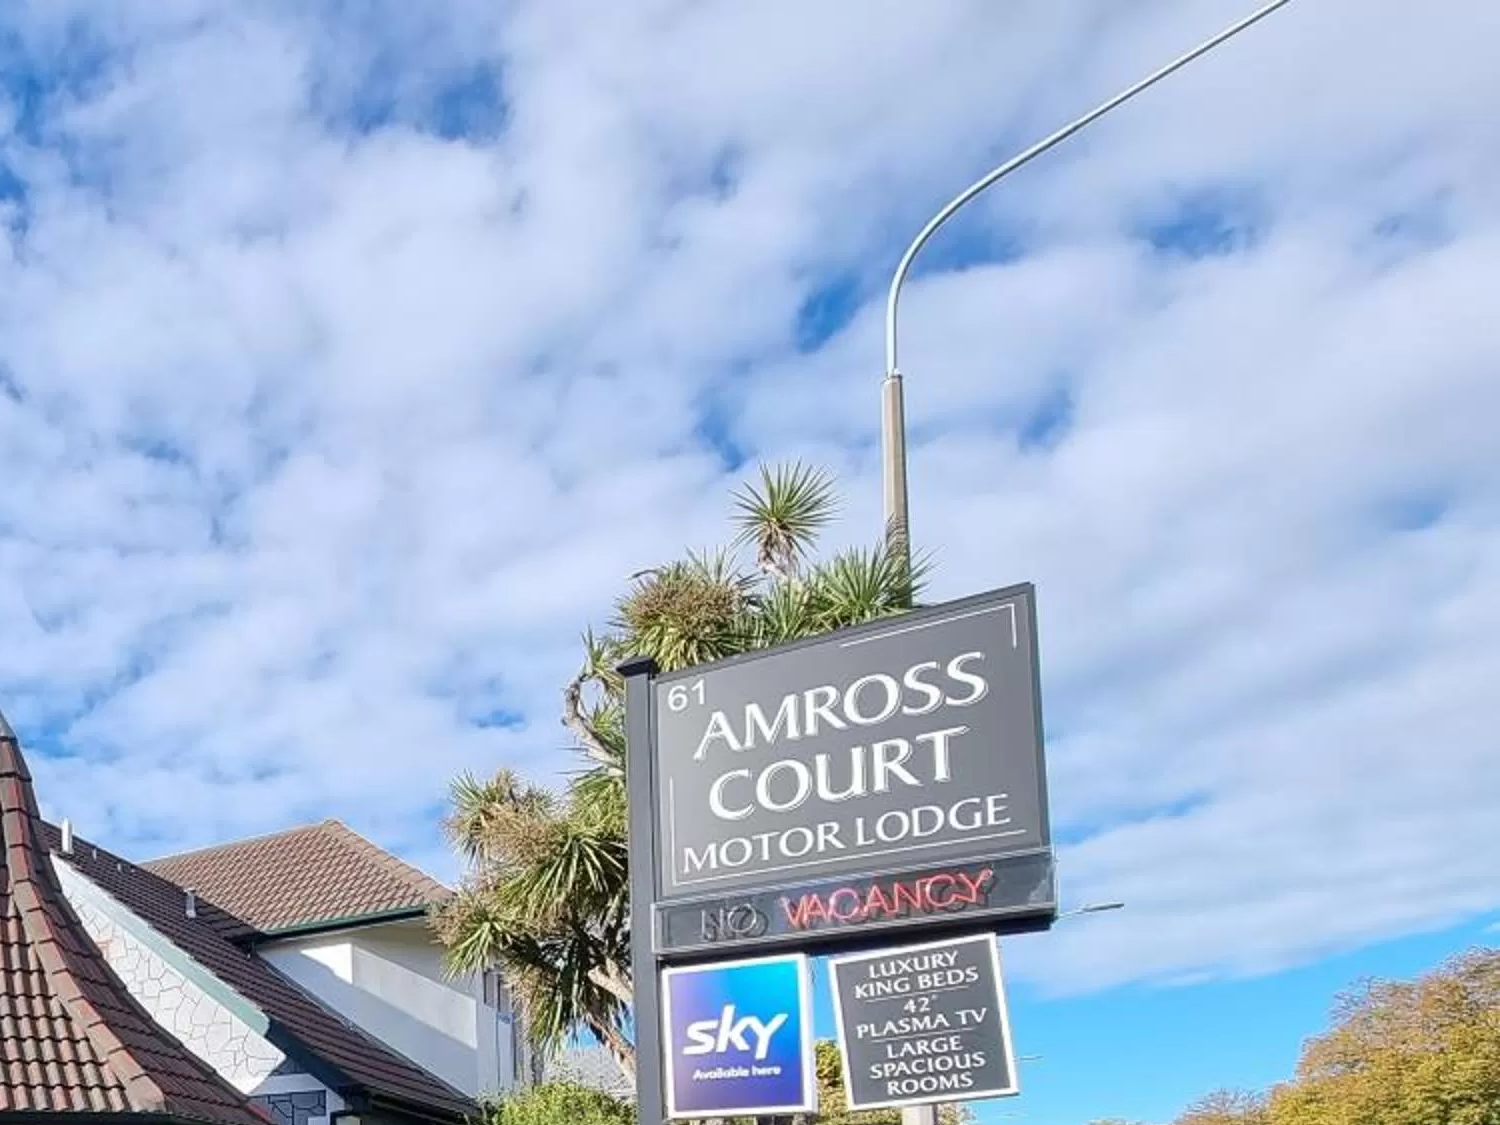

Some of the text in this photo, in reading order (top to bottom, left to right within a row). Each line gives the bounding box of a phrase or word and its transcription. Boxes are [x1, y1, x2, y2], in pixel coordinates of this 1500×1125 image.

[667, 679, 706, 711] 61
[693, 651, 989, 761] AMROSS
[709, 725, 970, 821] COURT
[682, 793, 1011, 873] MOTOR LODGE
[701, 867, 994, 936] NO VACANCY
[868, 951, 959, 979] LUXURY
[854, 966, 980, 999] KING BEDS
[682, 1004, 789, 1060] sky
[856, 1007, 988, 1039] PLASMA TV
[886, 1035, 964, 1059] LARGE
[693, 1065, 781, 1081] Available here
[870, 1051, 987, 1079] SPACIOUS
[886, 1072, 974, 1096] ROOMS
